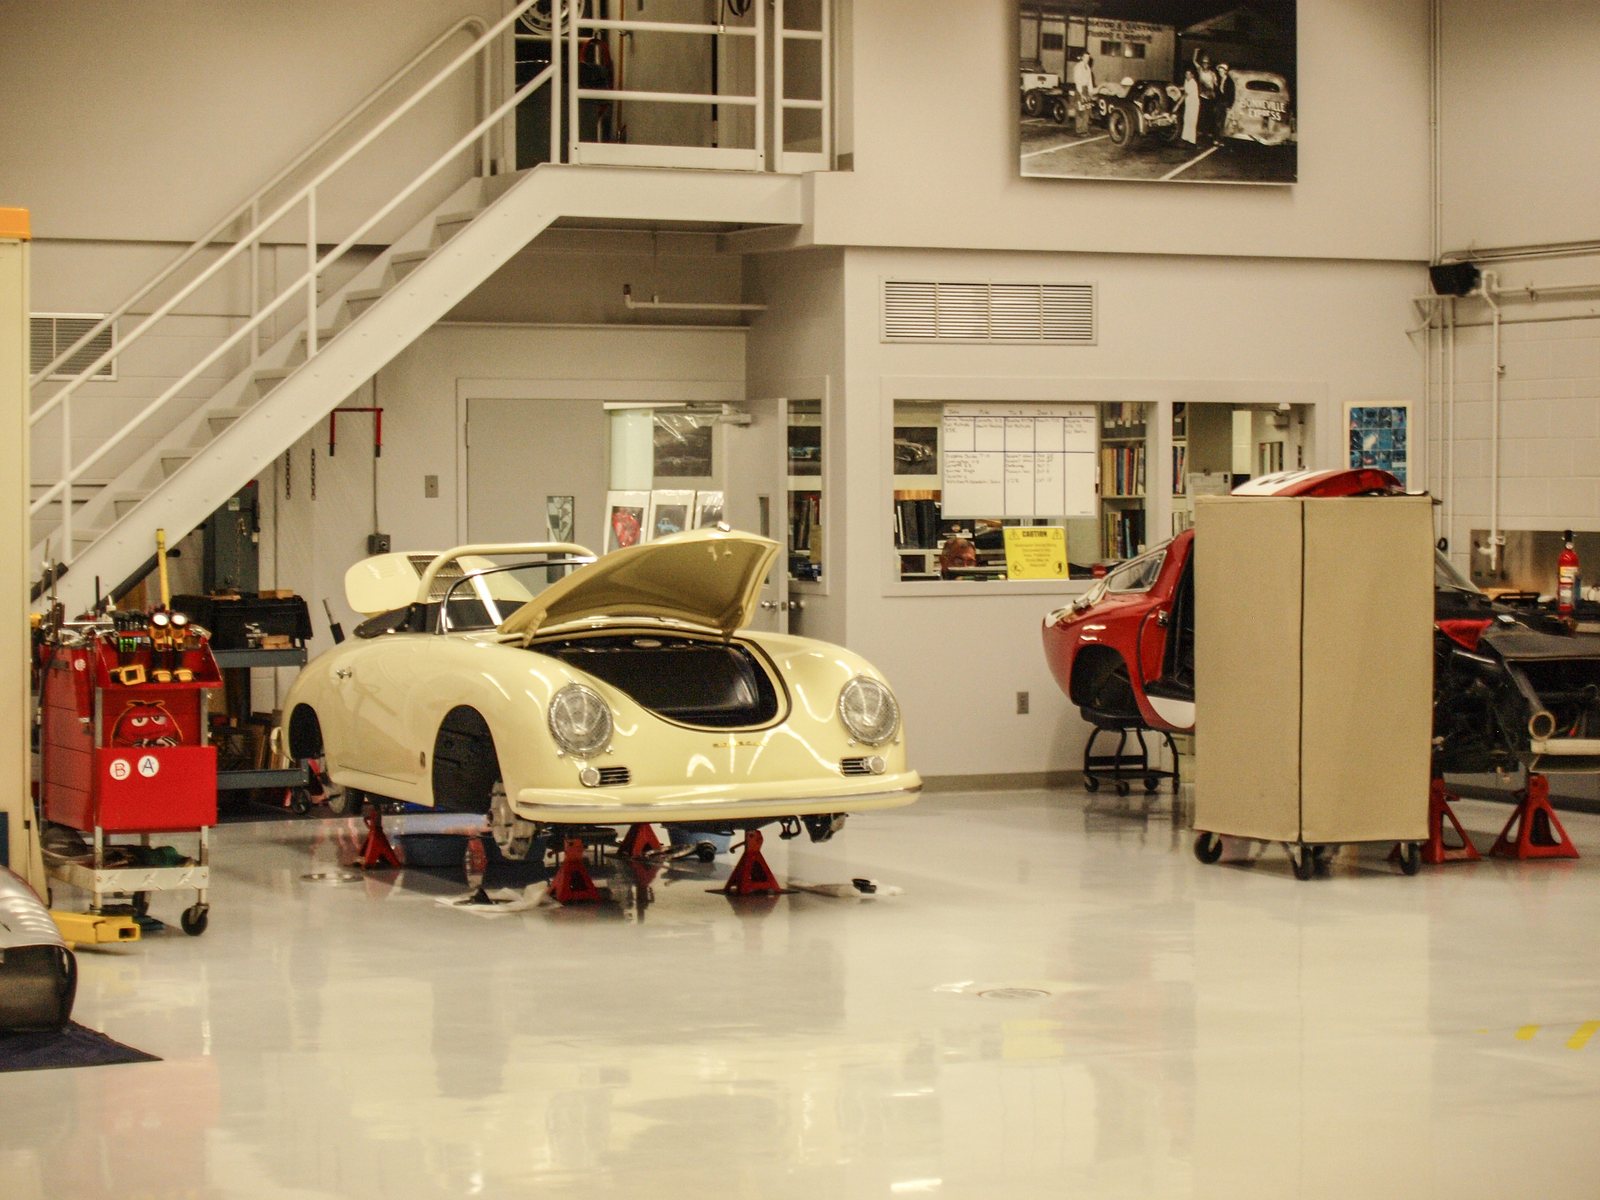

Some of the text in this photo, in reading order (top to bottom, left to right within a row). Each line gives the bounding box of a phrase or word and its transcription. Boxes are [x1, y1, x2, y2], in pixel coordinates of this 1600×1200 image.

[1022, 530, 1047, 538] CAUTION
[114, 762, 126, 777] B
[142, 758, 155, 773] A
